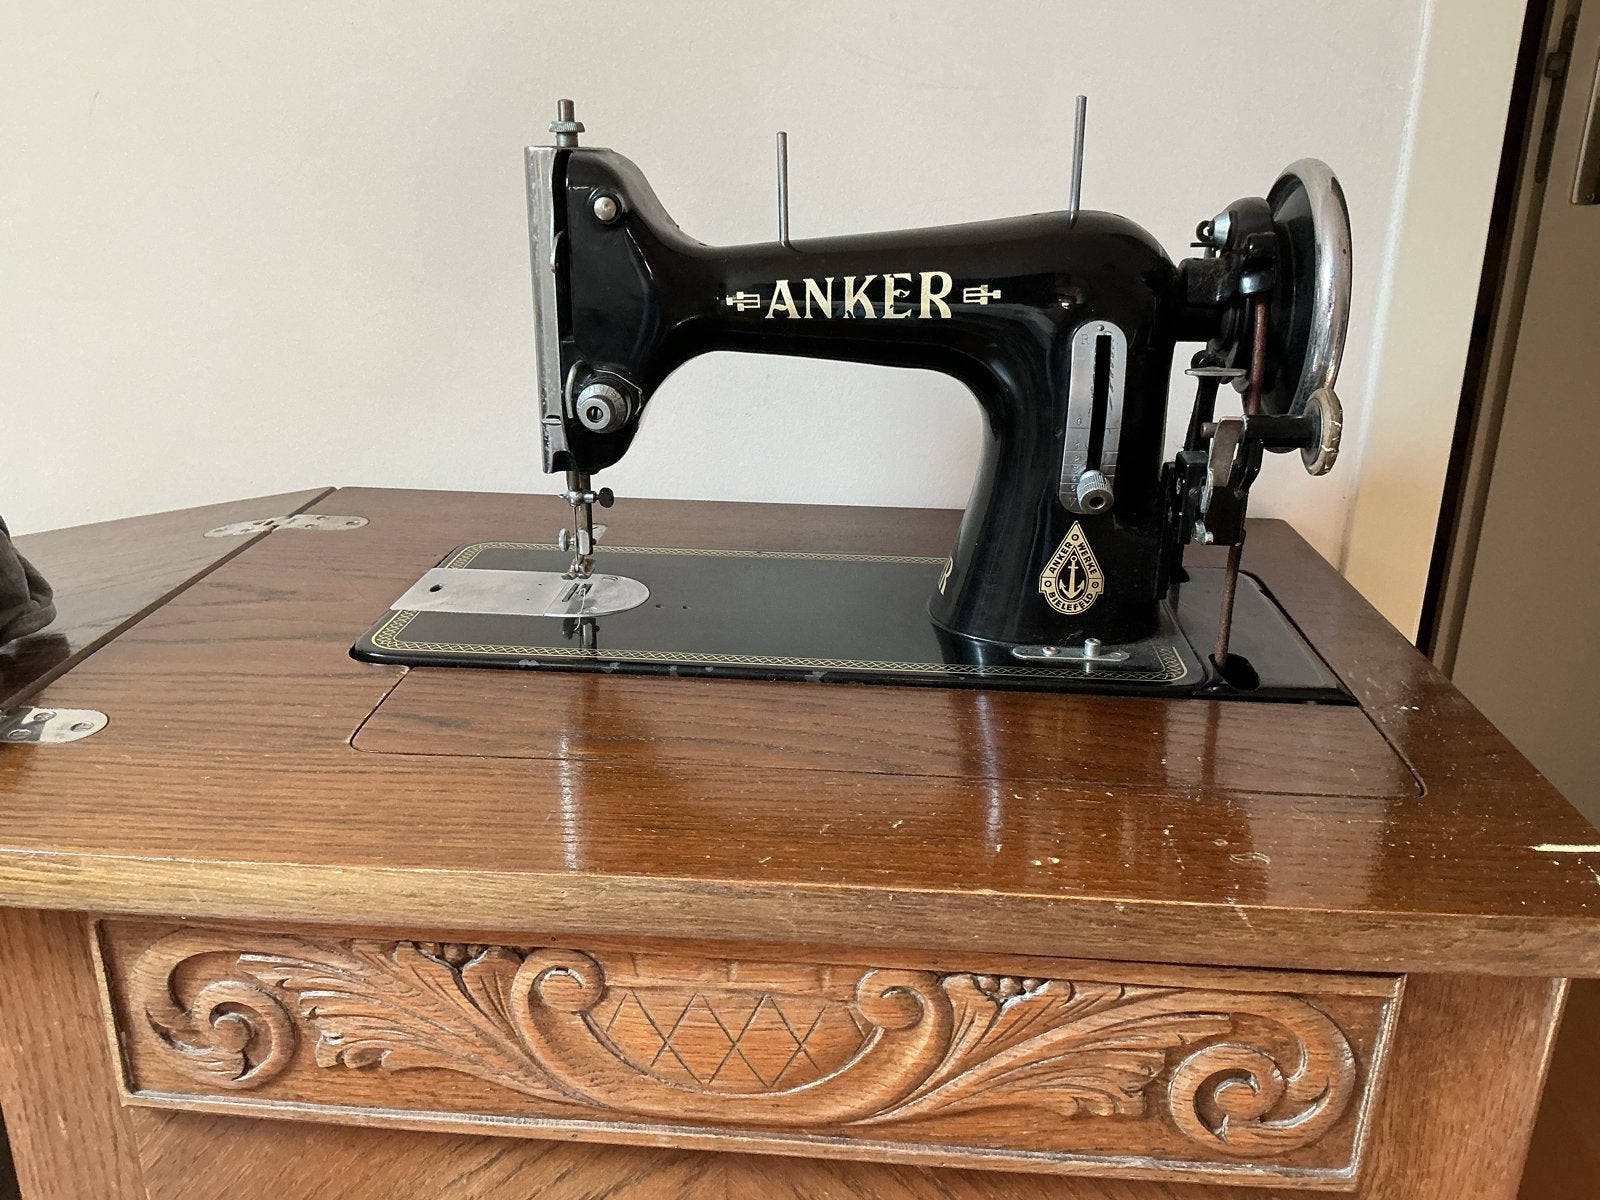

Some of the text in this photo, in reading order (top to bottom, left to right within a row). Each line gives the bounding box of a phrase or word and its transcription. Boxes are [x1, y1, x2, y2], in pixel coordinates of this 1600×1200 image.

[765, 271, 953, 320] ANKER
[1048, 541, 1098, 576] ANKER WERKE
[1048, 591, 1094, 611] BIELEFELD
